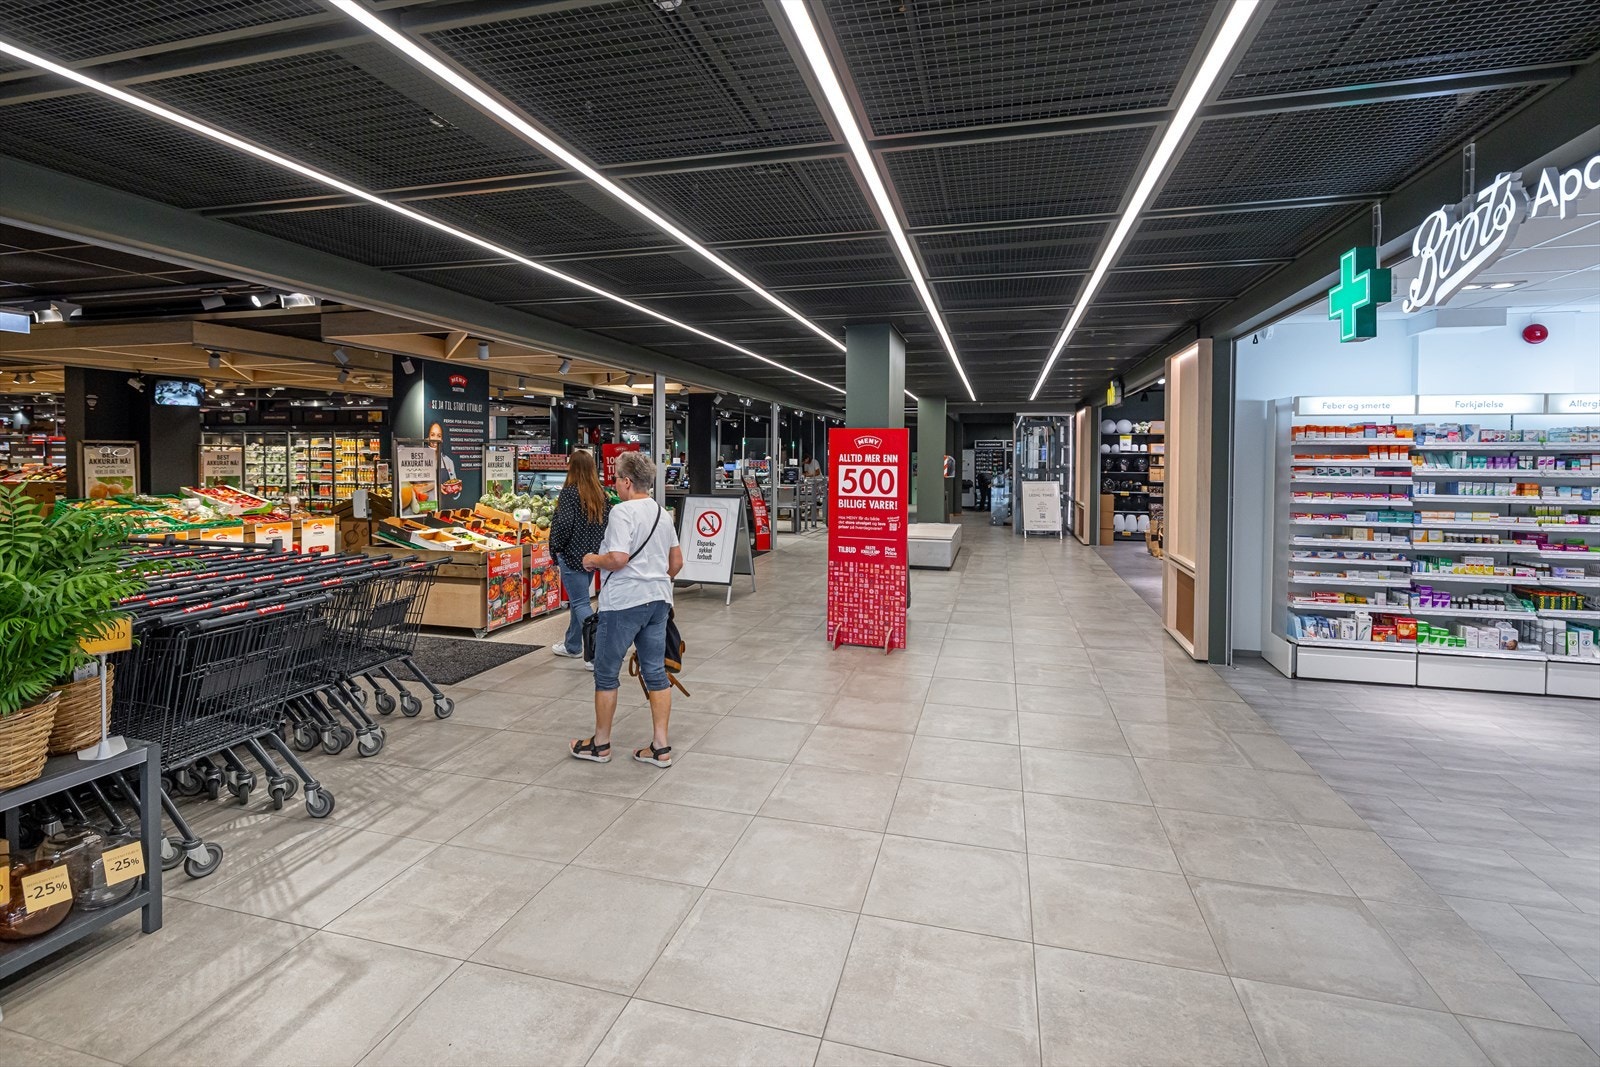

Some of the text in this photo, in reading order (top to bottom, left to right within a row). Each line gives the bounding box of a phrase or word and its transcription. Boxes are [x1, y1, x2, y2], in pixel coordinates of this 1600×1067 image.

[1402, 173, 1517, 314] Boots
[444, 400, 453, 411] TIL
[453, 401, 466, 412] STORT
[1322, 401, 1346, 409] Feber
[1348, 402, 1359, 411] og
[1455, 399, 1504, 409] Forkjølelse
[838, 453, 898, 463] ALLTID MER ENN
[841, 468, 895, 495] 500
[838, 499, 898, 510] BILLIGE VARER!
[838, 545, 857, 554] TILBUD
[110, 857, 140, 872] -25%
[27, 881, 68, 900] -25%
